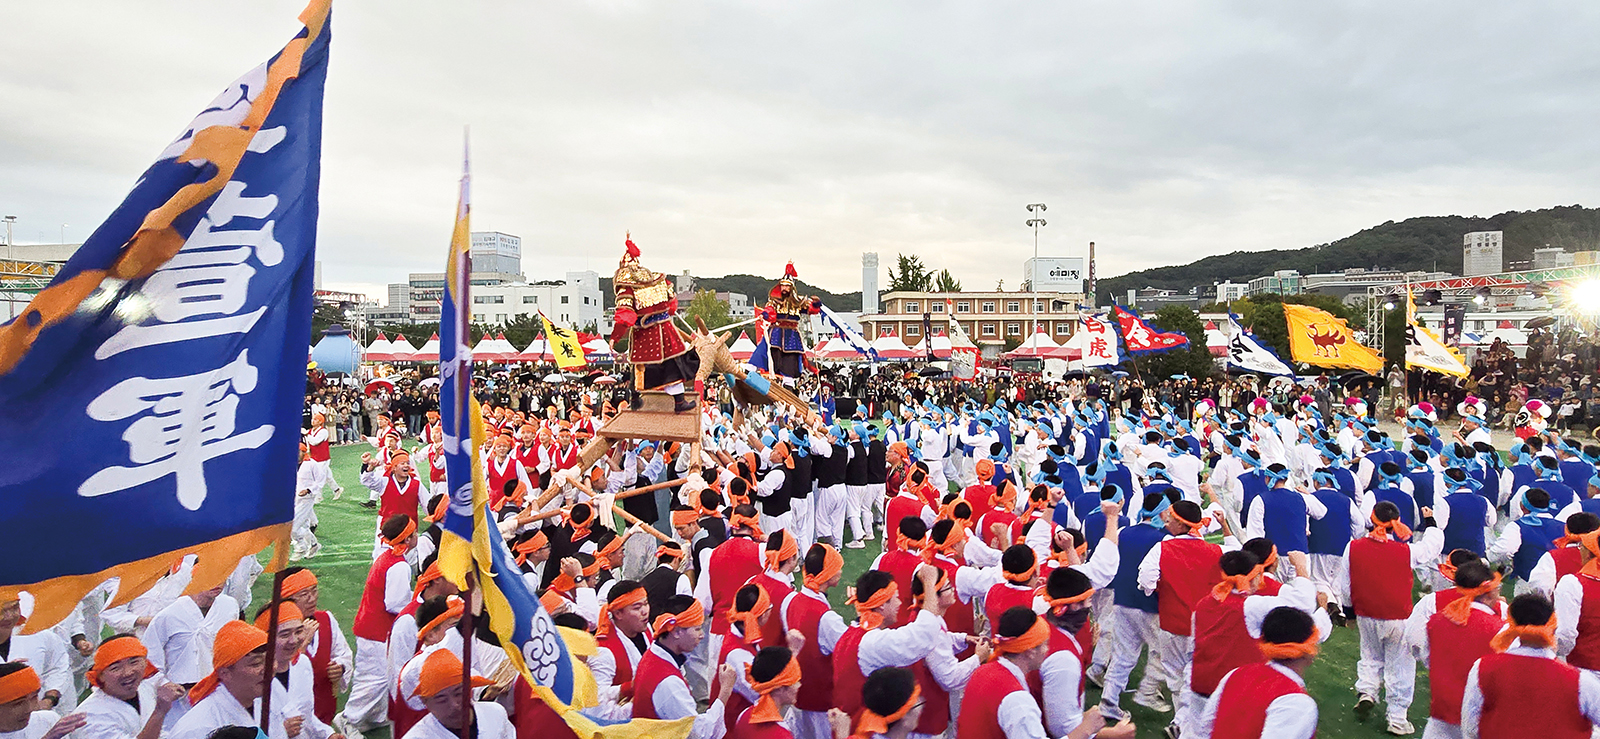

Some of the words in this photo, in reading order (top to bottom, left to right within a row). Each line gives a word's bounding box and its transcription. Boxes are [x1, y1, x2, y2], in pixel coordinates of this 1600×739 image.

[1049, 269, 1080, 280] 예미정
[78, 126, 287, 511] 萱軍
[1085, 316, 1112, 359] 白虎
